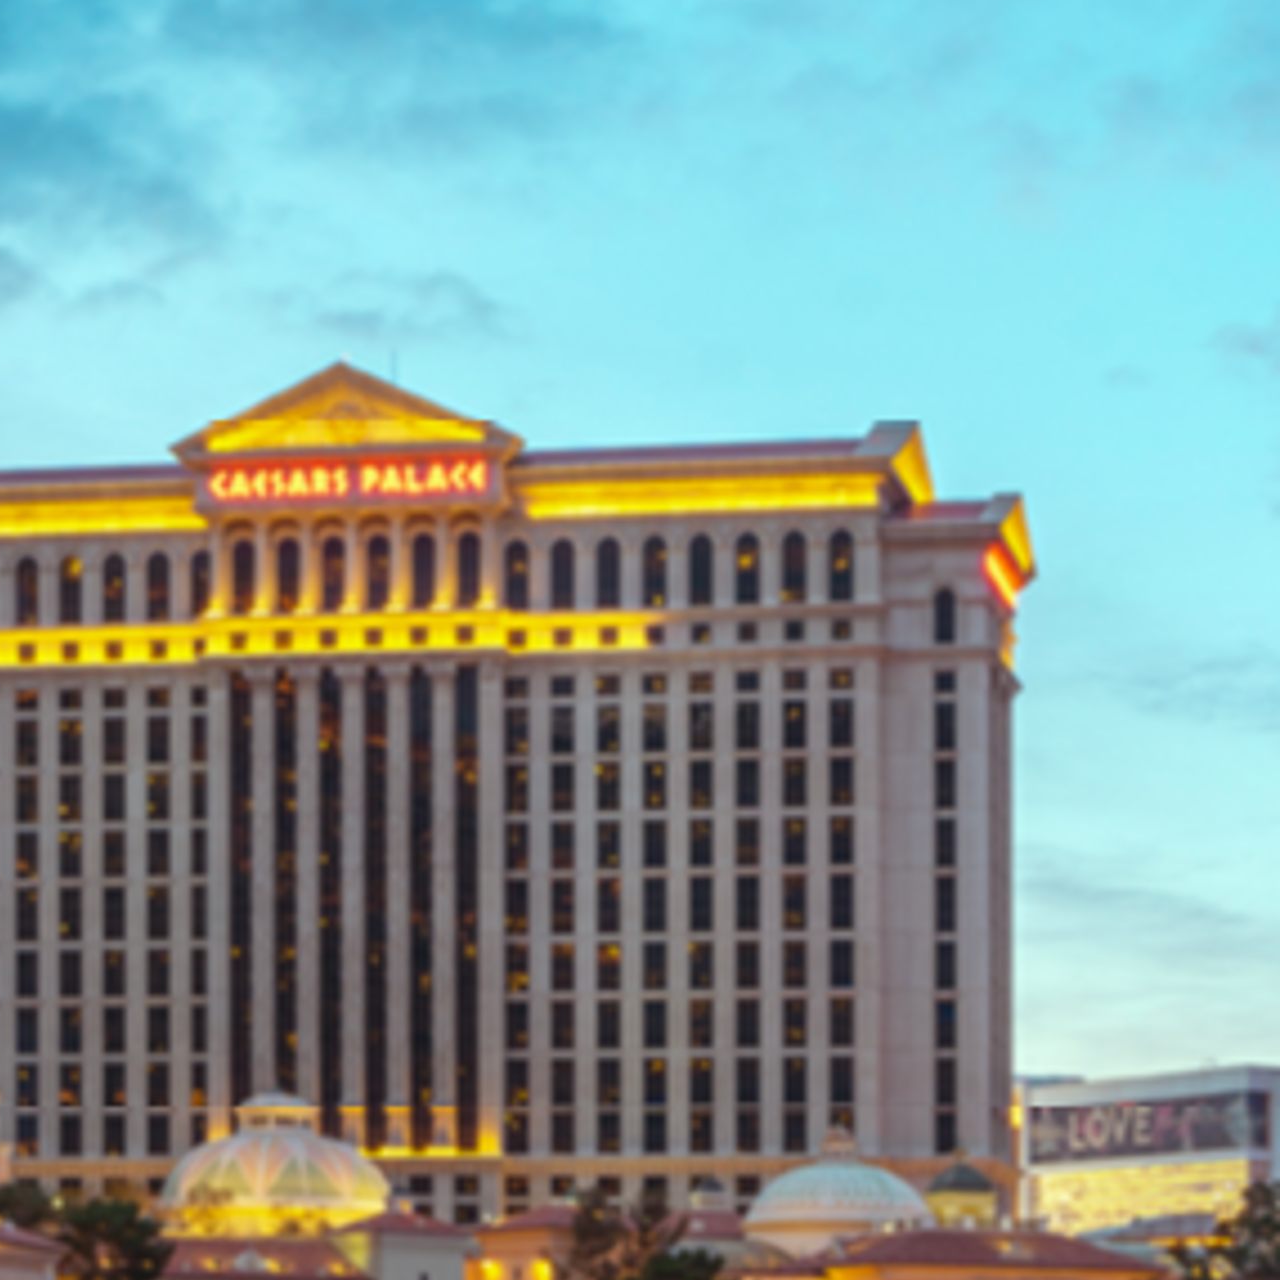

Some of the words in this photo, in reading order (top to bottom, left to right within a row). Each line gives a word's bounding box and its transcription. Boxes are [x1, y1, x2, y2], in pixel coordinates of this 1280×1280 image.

[209, 467, 347, 498] CAESARS
[362, 462, 485, 493] PALACE
[1068, 1105, 1153, 1152] LOVE
